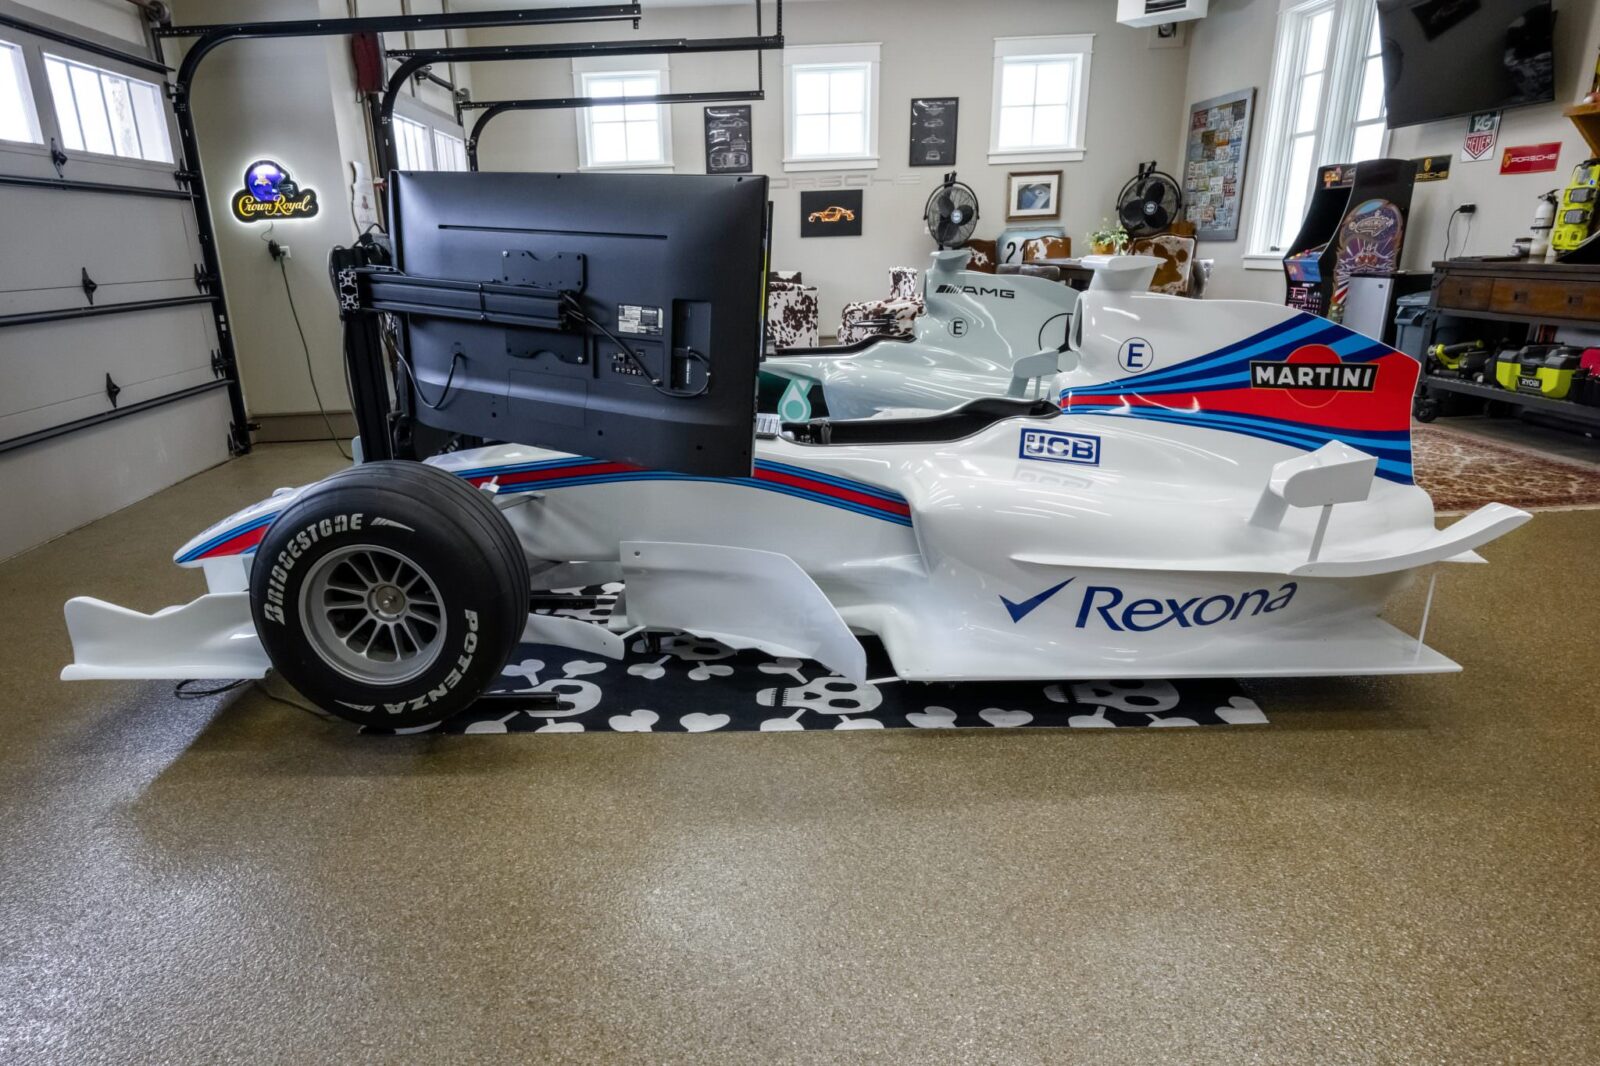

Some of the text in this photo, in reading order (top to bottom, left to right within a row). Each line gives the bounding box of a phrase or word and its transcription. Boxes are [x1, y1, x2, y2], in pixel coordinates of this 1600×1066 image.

[1473, 114, 1493, 132] TAG
[1467, 136, 1492, 155] HEUER
[1511, 153, 1557, 163] PORSCHE
[769, 174, 921, 189] ORSCHE
[238, 193, 310, 217] Crown Royal
[961, 286, 1016, 299] AMG
[953, 320, 964, 335] E
[1127, 343, 1145, 367] E
[1255, 366, 1373, 388] MARTINI
[1521, 378, 1540, 388] RYOBI
[1026, 434, 1094, 460] JCB
[264, 513, 364, 626] BRIDGESTONE
[1075, 582, 1298, 632] Rexona
[383, 609, 479, 714] POTENZA
